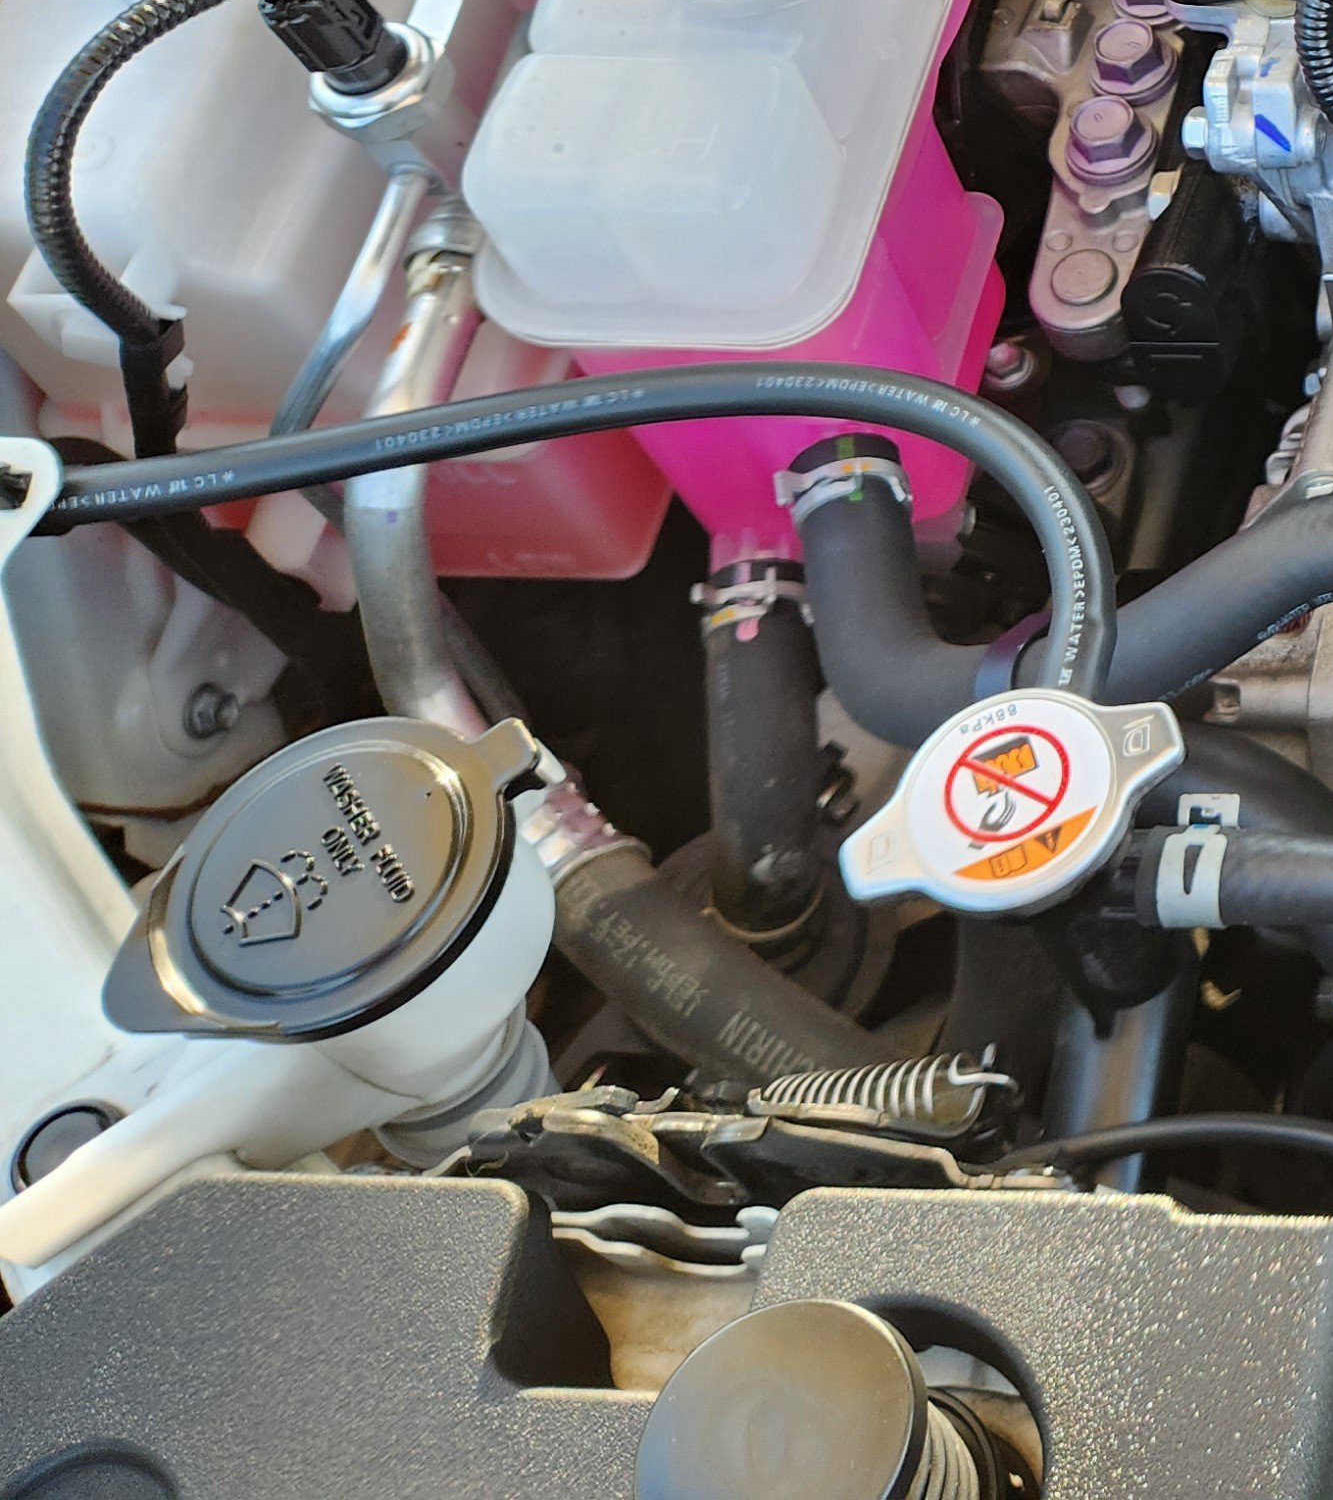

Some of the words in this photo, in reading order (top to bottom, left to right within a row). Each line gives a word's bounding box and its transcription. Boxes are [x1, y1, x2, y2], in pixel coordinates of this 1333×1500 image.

[319, 825, 366, 878] ONLY
[320, 760, 381, 847] WASHER
[369, 842, 418, 905] FLUID
